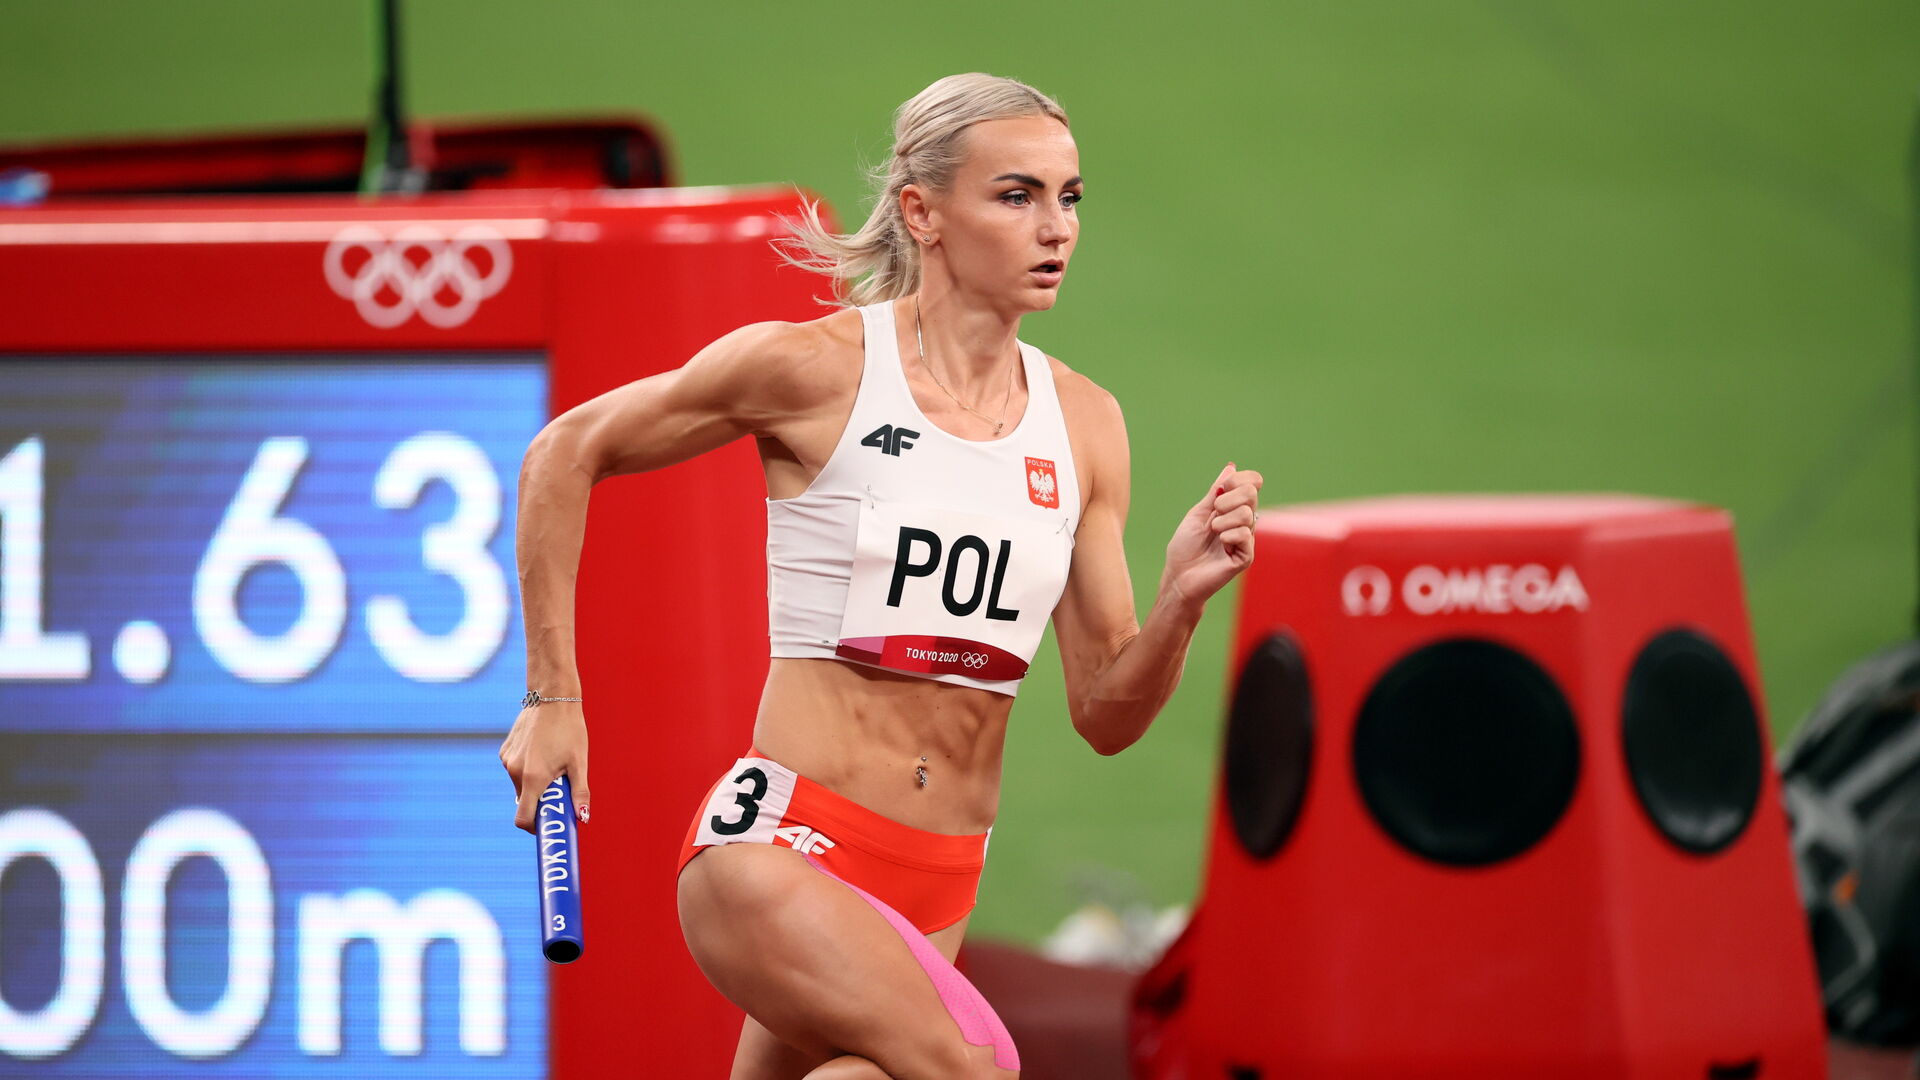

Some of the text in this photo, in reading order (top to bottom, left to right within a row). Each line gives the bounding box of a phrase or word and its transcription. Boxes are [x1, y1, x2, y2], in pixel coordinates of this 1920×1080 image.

[860, 423, 921, 457] 4F
[1027, 459, 1054, 468] POLSKA
[0, 431, 511, 684] 1.63
[886, 526, 1020, 621] POL
[1402, 563, 1590, 615] OMEGA
[906, 647, 959, 663] TOKYO 2020
[710, 766, 768, 835] 3
[541, 820, 569, 900] TOKYO
[552, 914, 567, 931] 3
